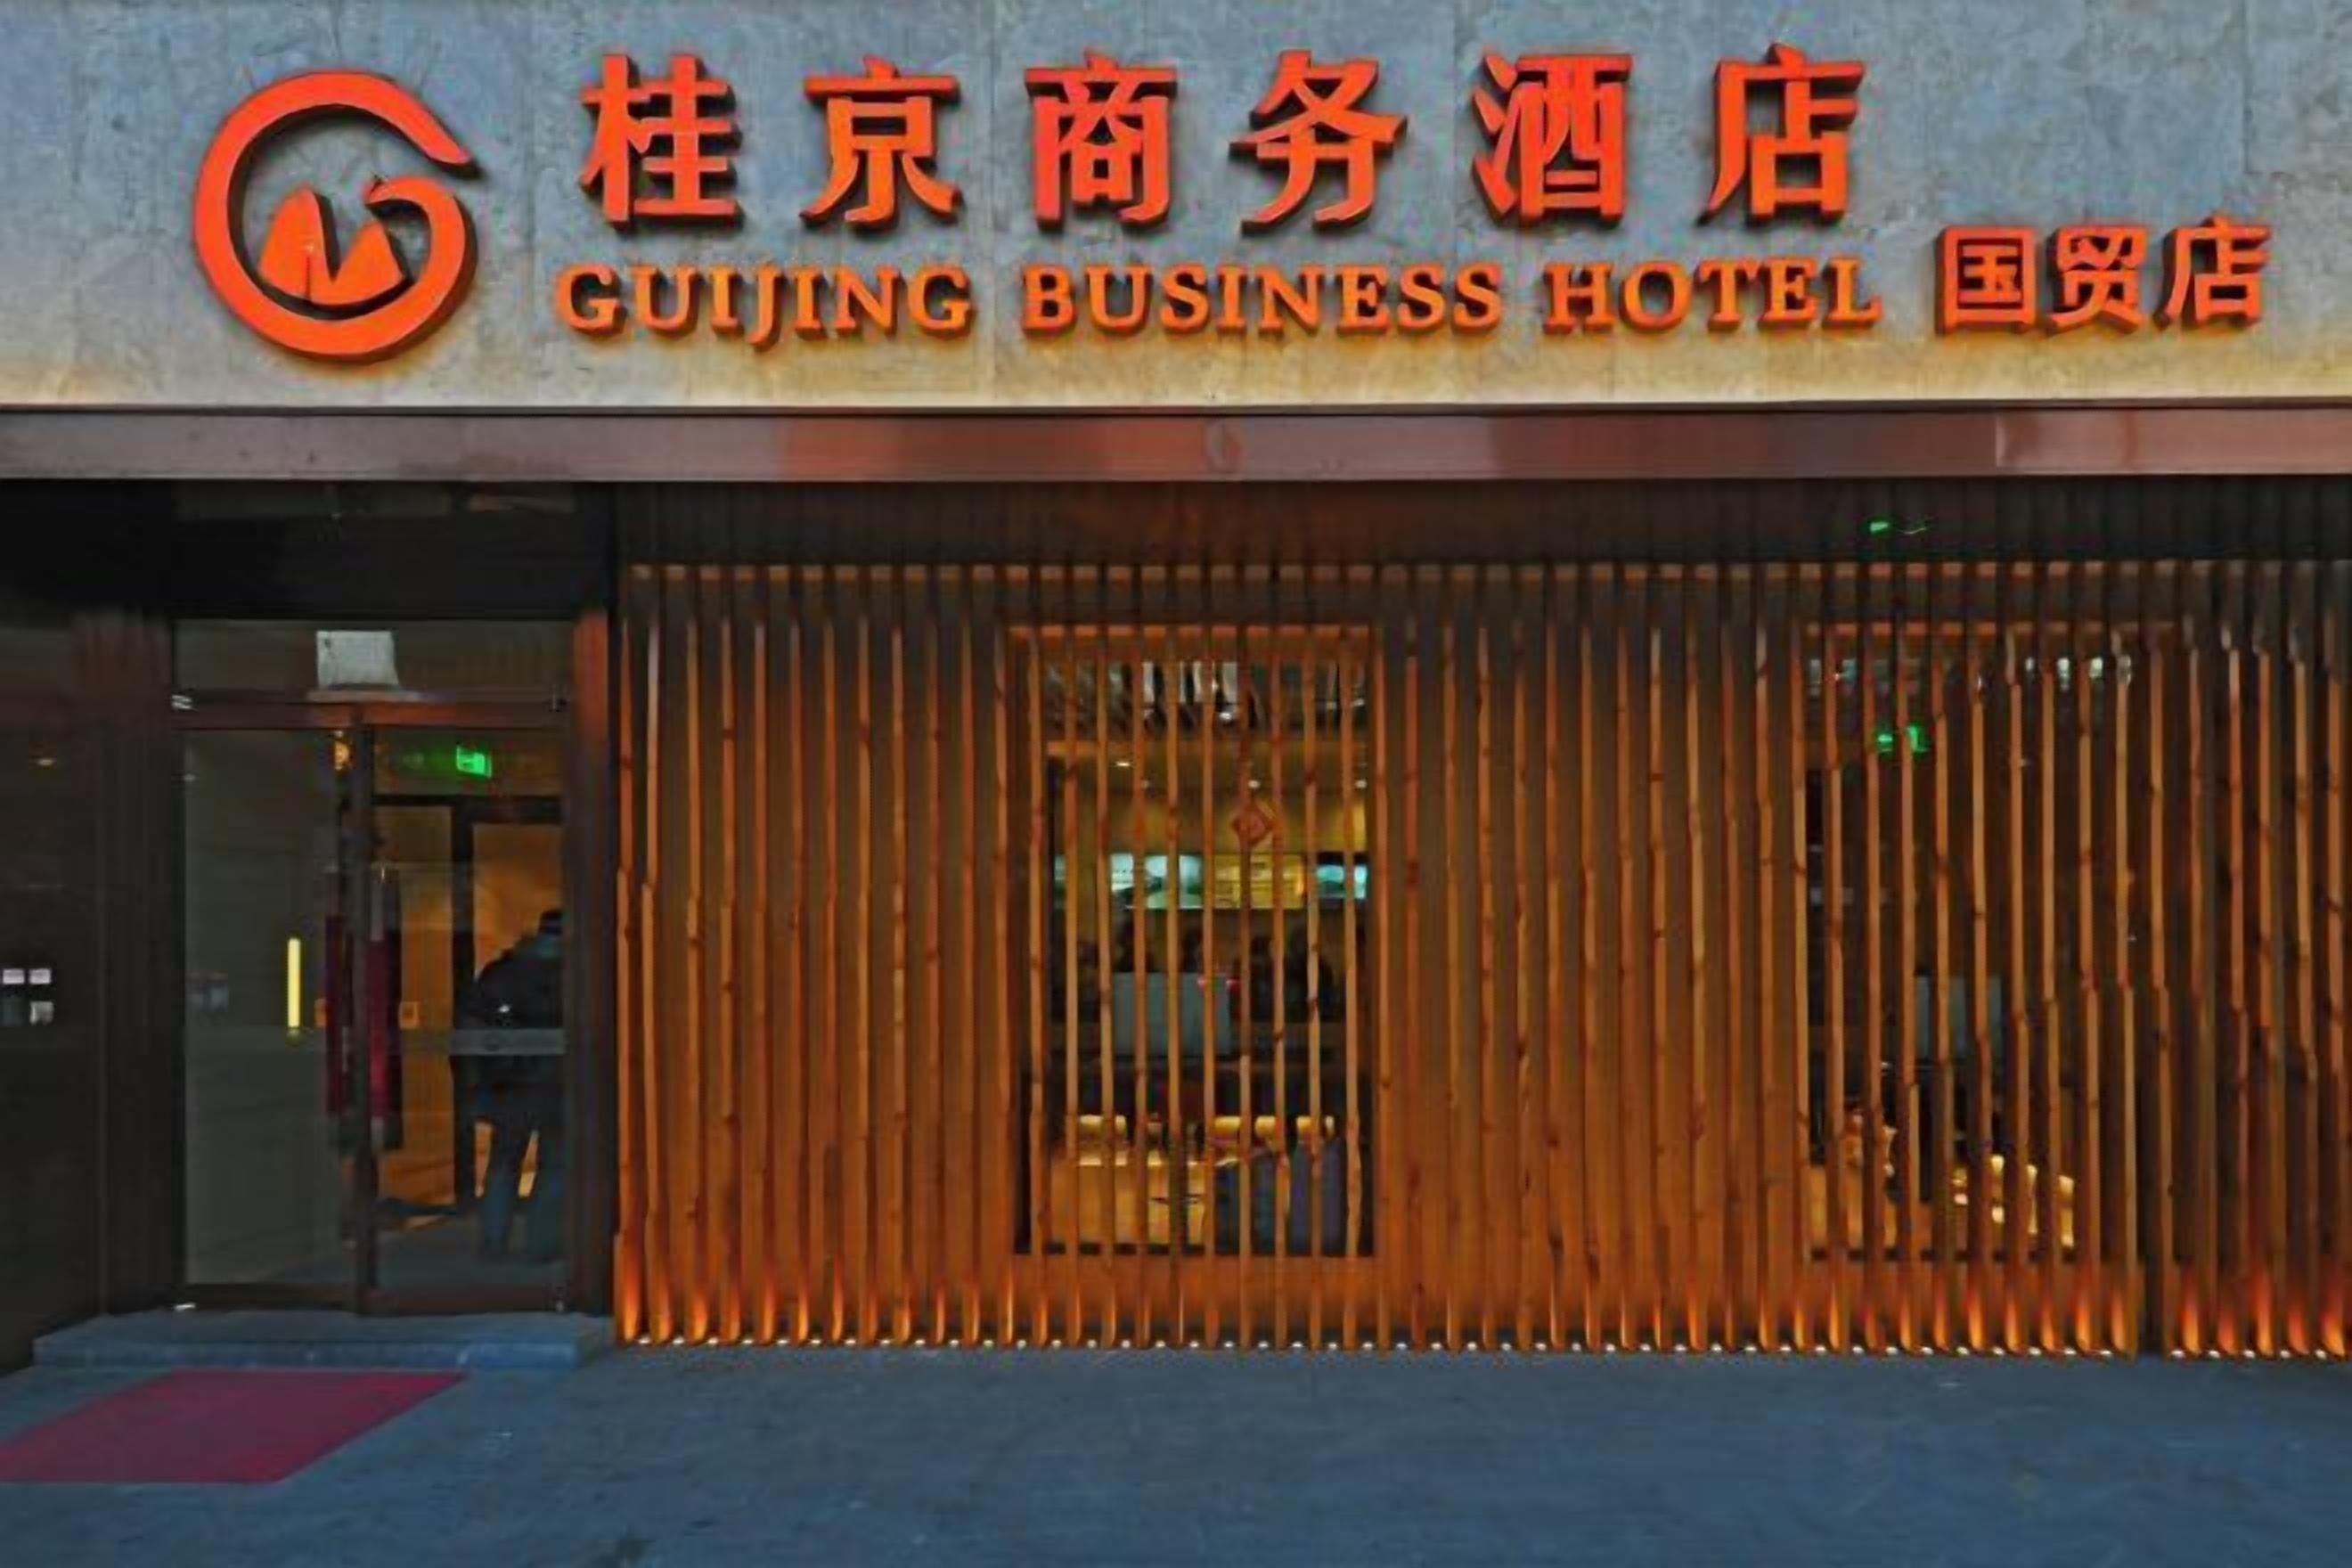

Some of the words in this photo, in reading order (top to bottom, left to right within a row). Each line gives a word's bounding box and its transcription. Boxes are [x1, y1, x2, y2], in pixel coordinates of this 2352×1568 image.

[580, 44, 1866, 225] 桂京商务酒店
[556, 263, 973, 347] GUIJING
[1023, 261, 1501, 335] BUSINESS
[1545, 257, 1879, 331] HOTEL
[1937, 214, 2270, 331] 国贸店
